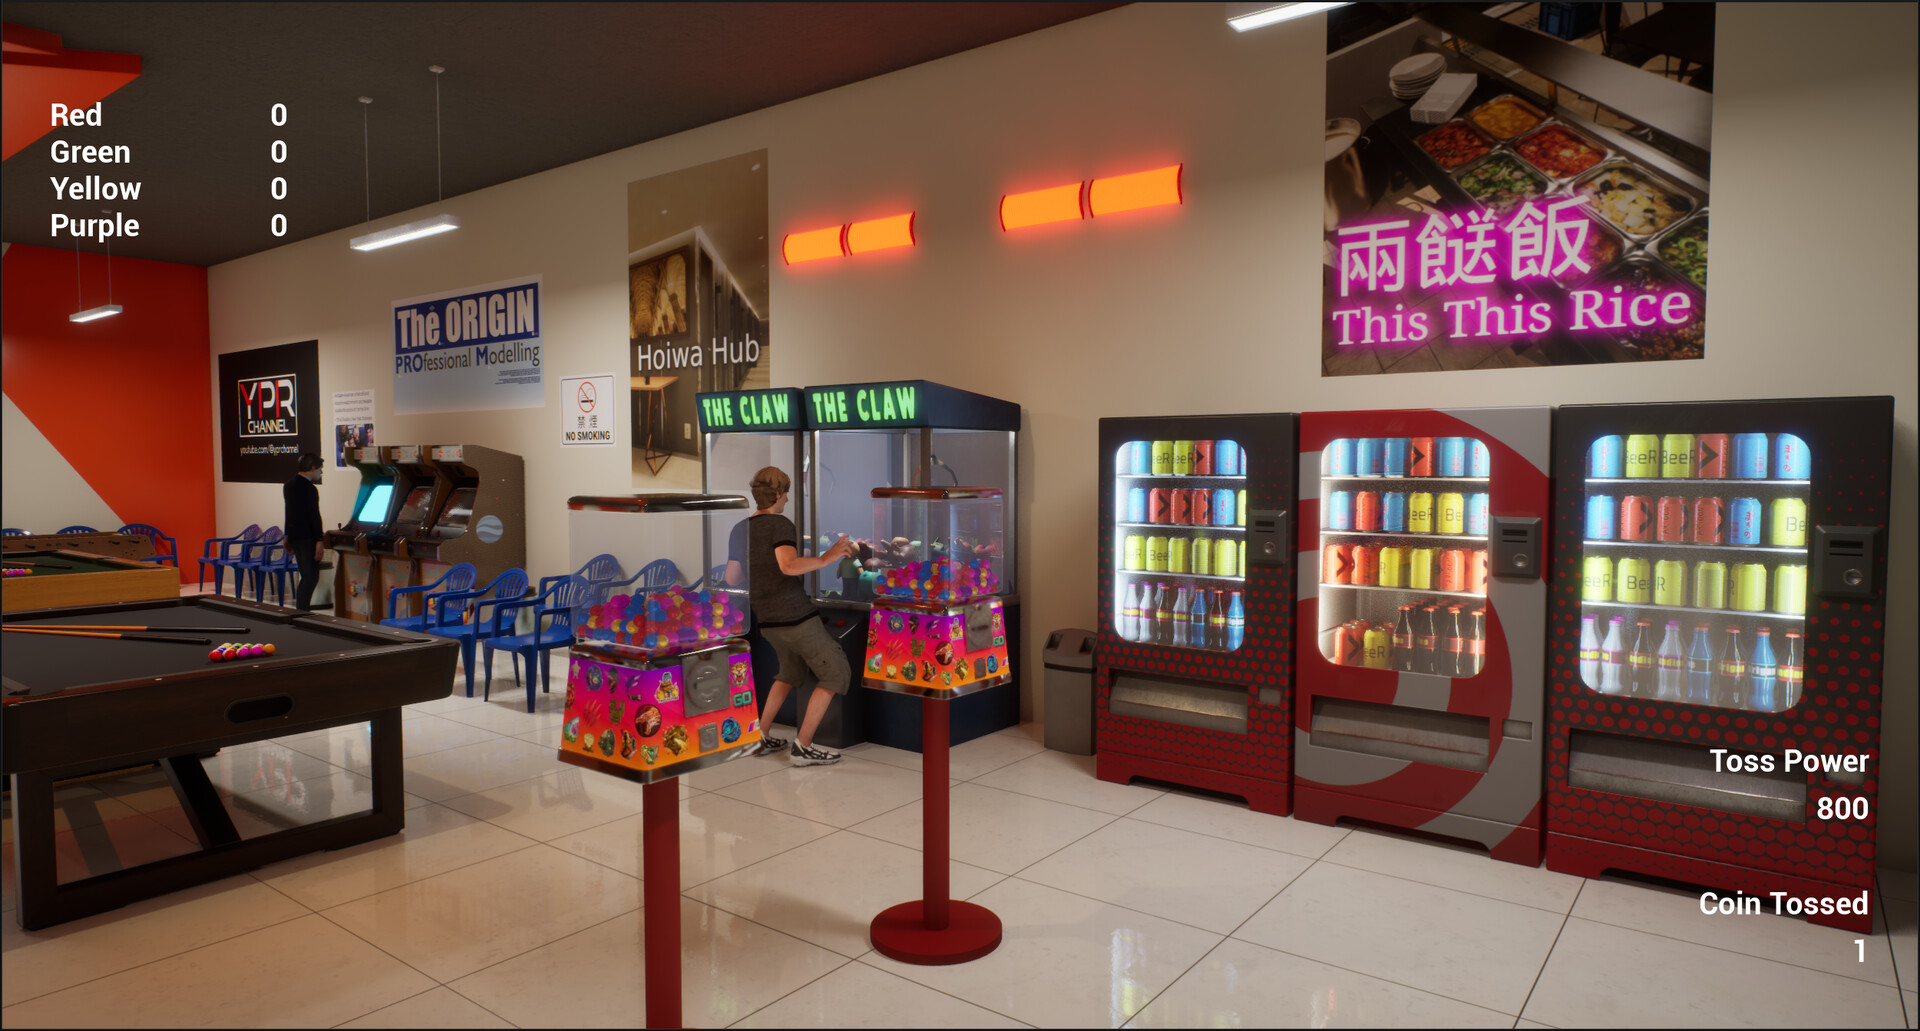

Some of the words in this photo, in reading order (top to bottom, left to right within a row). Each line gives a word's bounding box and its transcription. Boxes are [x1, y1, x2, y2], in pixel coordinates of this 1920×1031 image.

[1337, 195, 1592, 297] 兩餸飯
[397, 308, 441, 350] The
[445, 288, 535, 343] ORIGIN
[1332, 303, 1429, 346] This
[1443, 293, 1552, 338] This
[1569, 285, 1691, 331] Rice
[395, 348, 472, 374] PROfessional
[476, 342, 541, 367] Modelling
[637, 341, 703, 371] Hoiwa
[712, 333, 760, 365] Hub
[240, 379, 296, 419] YPR
[702, 397, 734, 427] THE
[739, 393, 789, 425] CLAW
[812, 391, 848, 424] THE
[856, 386, 915, 422] CLAW
[247, 419, 289, 434] CHANNEL
[565, 431, 576, 441] NO
[577, 430, 611, 441] SMOKING
[993, 634, 1005, 647] GO
[733, 690, 752, 707] GO
